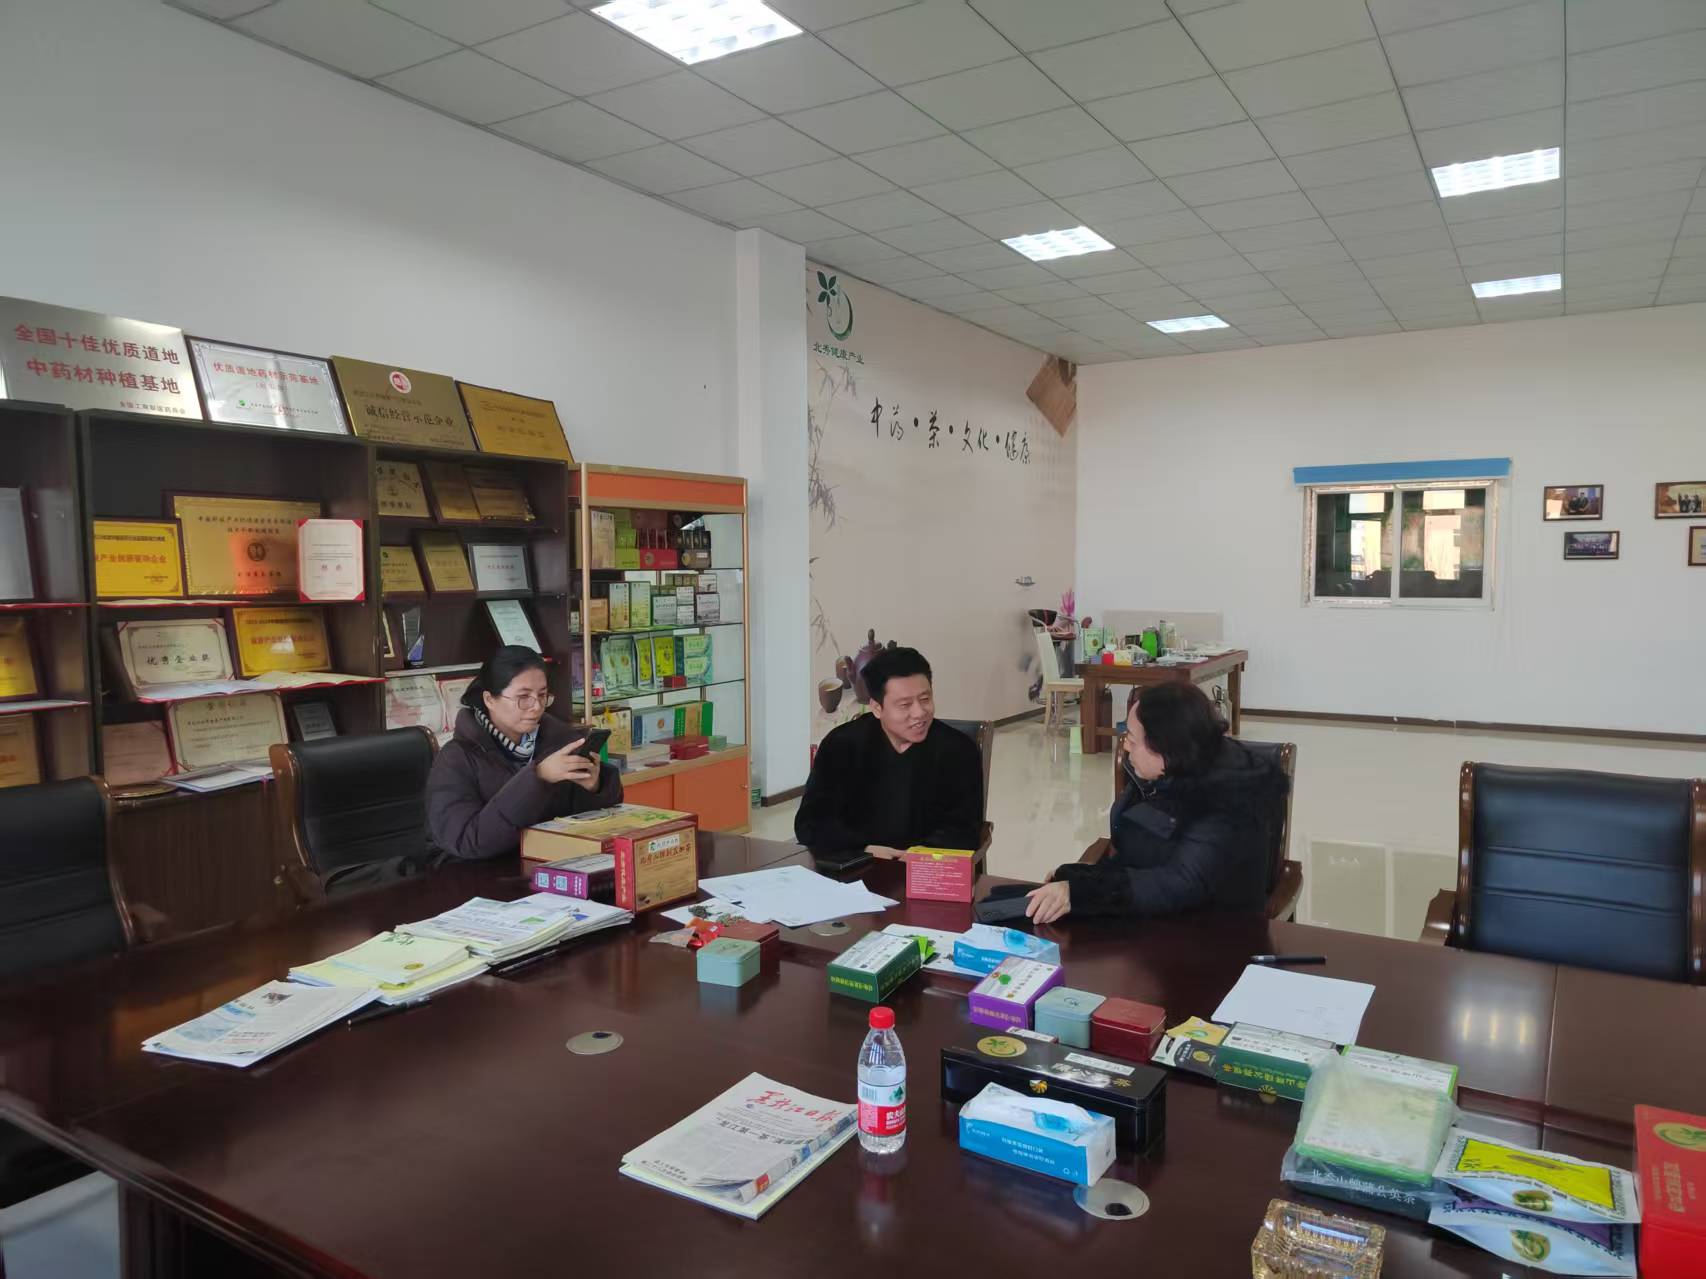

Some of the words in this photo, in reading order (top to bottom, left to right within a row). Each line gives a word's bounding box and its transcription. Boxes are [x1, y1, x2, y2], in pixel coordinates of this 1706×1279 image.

[14, 322, 181, 365] 全国十佳优质道地
[26, 357, 182, 395] 中药材种植基地
[745, 1090, 843, 1123] 黑龙江日报
